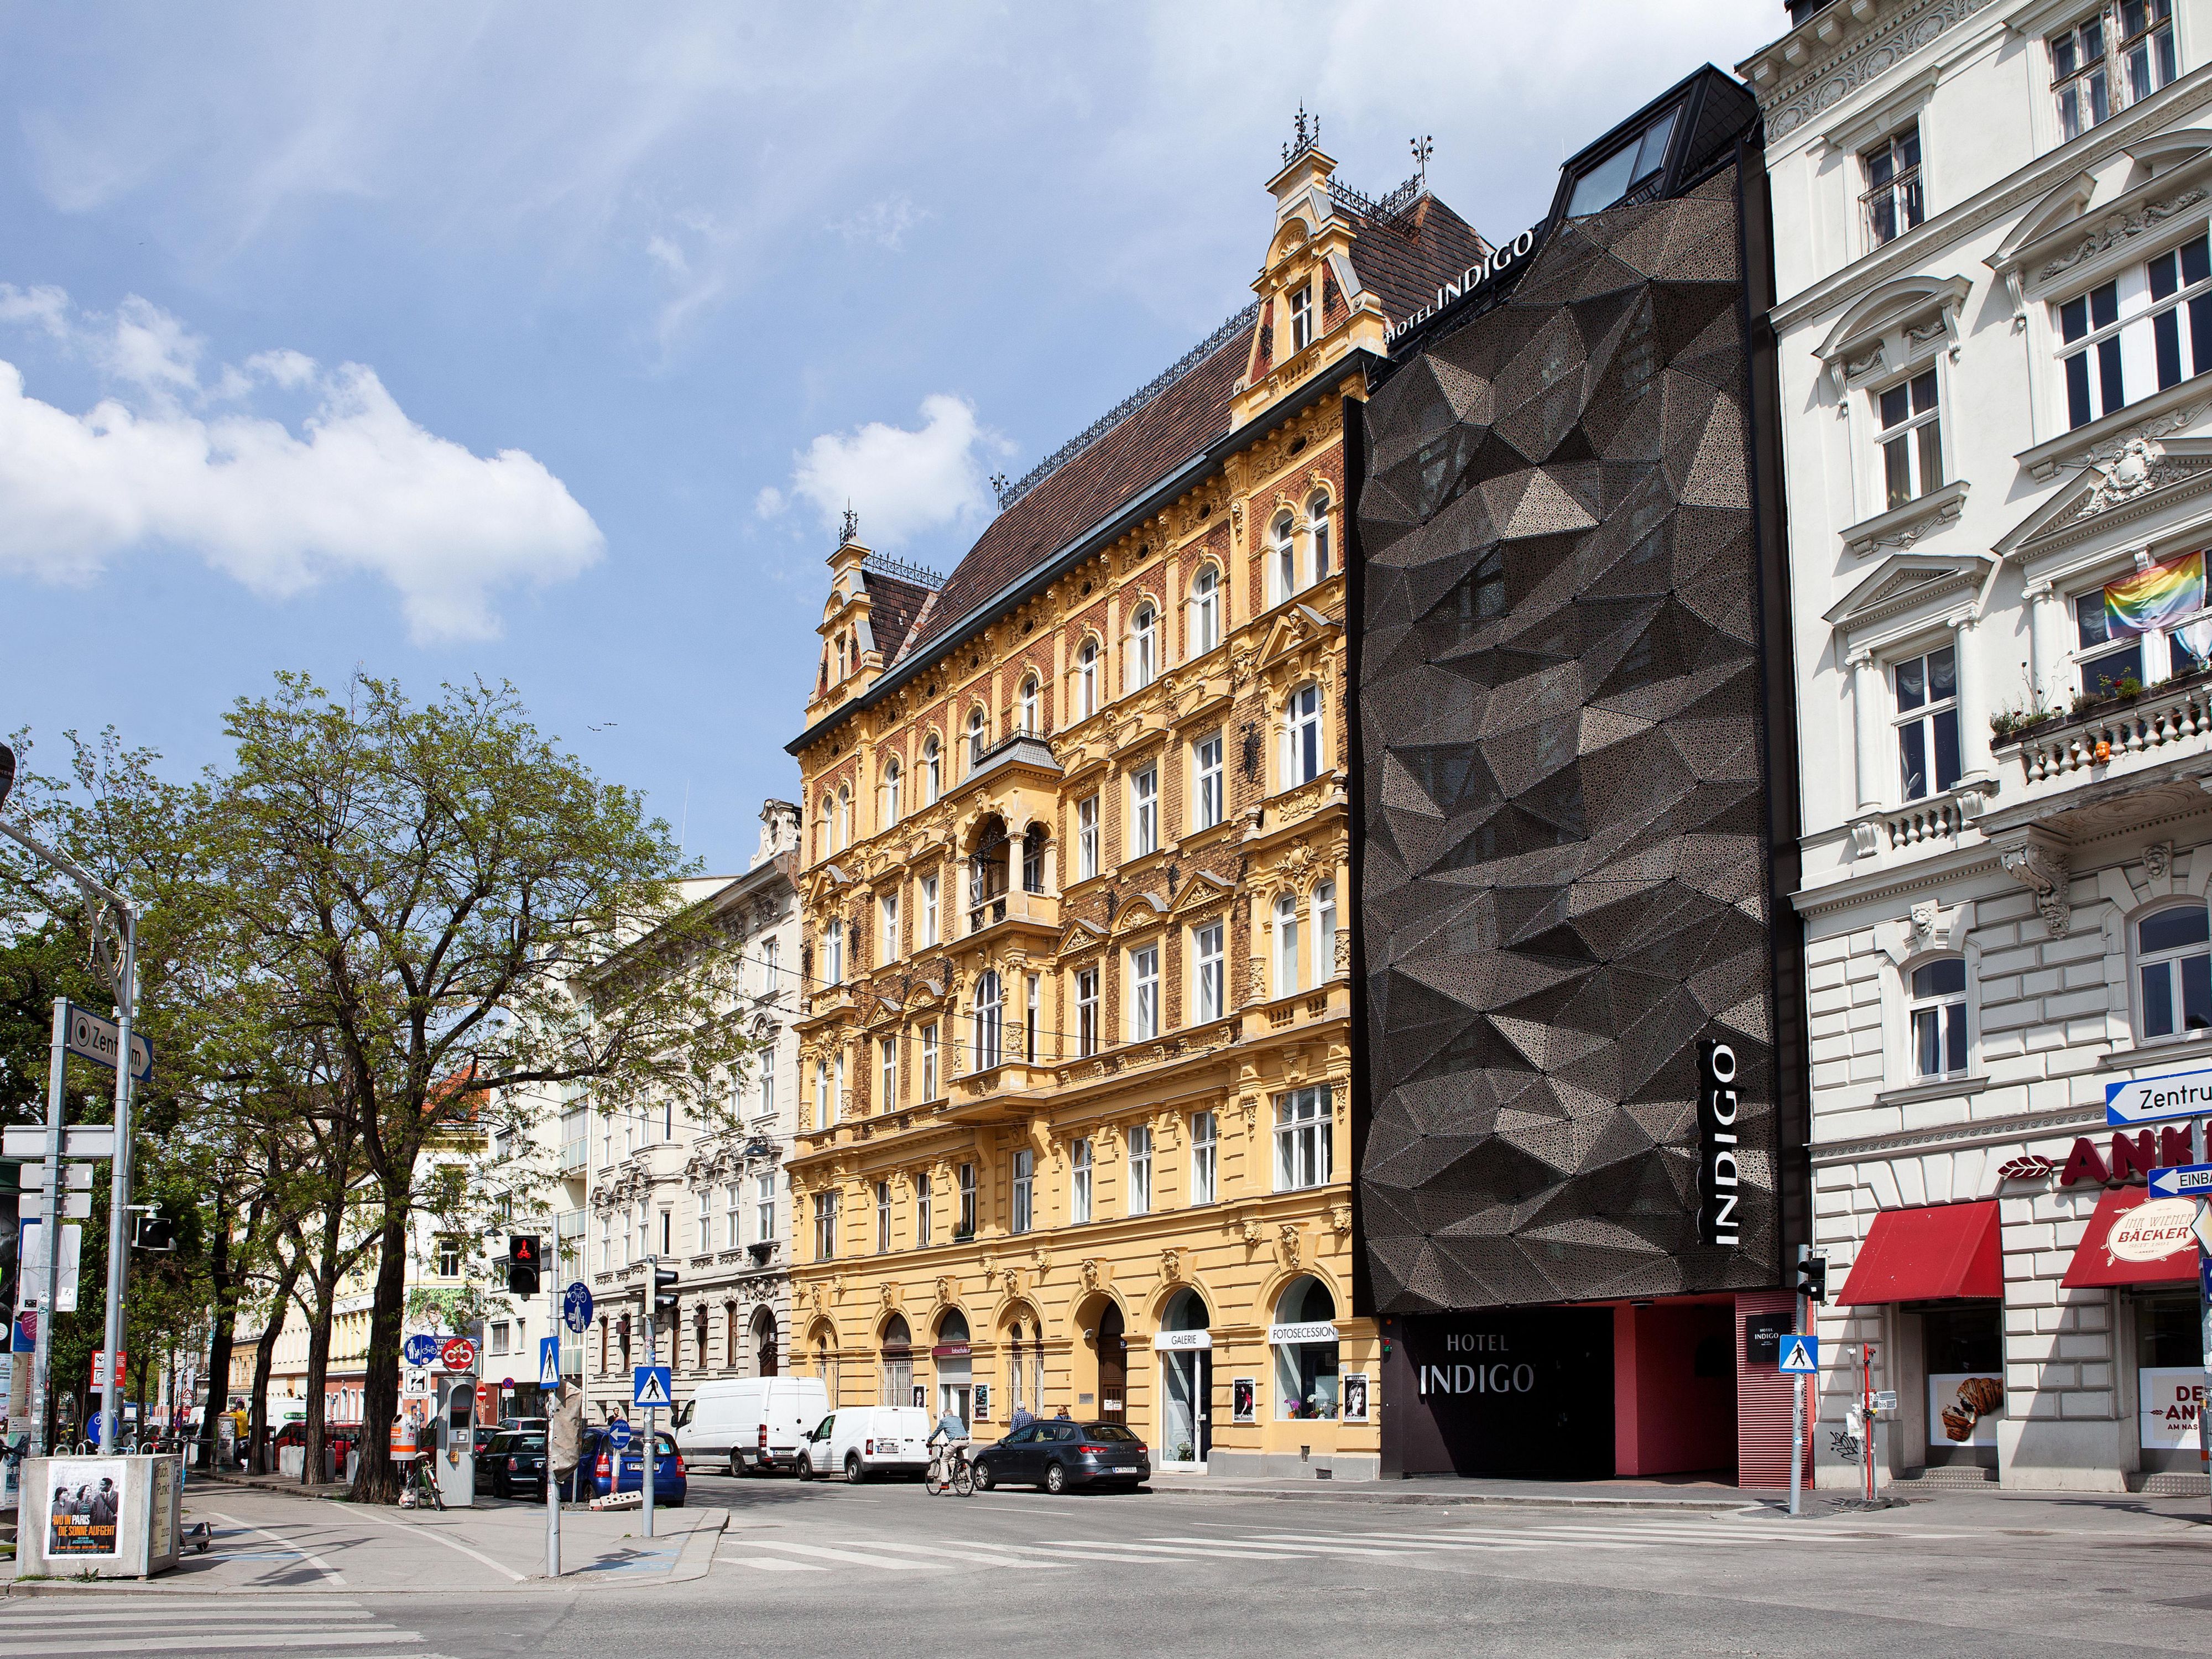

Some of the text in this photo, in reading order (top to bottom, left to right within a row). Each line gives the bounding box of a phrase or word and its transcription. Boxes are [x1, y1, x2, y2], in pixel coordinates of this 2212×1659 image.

[1385, 230, 1533, 345] HOTEL INDIGO
[92, 1026, 140, 1067] Zentm
[1713, 1045, 1739, 1244] INDIGO
[2060, 1120, 2212, 1186] ANK
[2124, 1214, 2194, 1228] IHR WIENER
[2117, 1228, 2188, 1243] BÄCKER
[1171, 1335, 1196, 1344] GALERIE
[1274, 1327, 1334, 1339] FOTOSECESSION
[1447, 1334, 1509, 1351] HOTEL
[1421, 1364, 1534, 1394] INDIGO
[157, 1483, 170, 1496] Punkt
[53, 1514, 90, 1525] WO IN PARIS
[58, 1525, 115, 1536] DIE SONNE AUFGEHT
